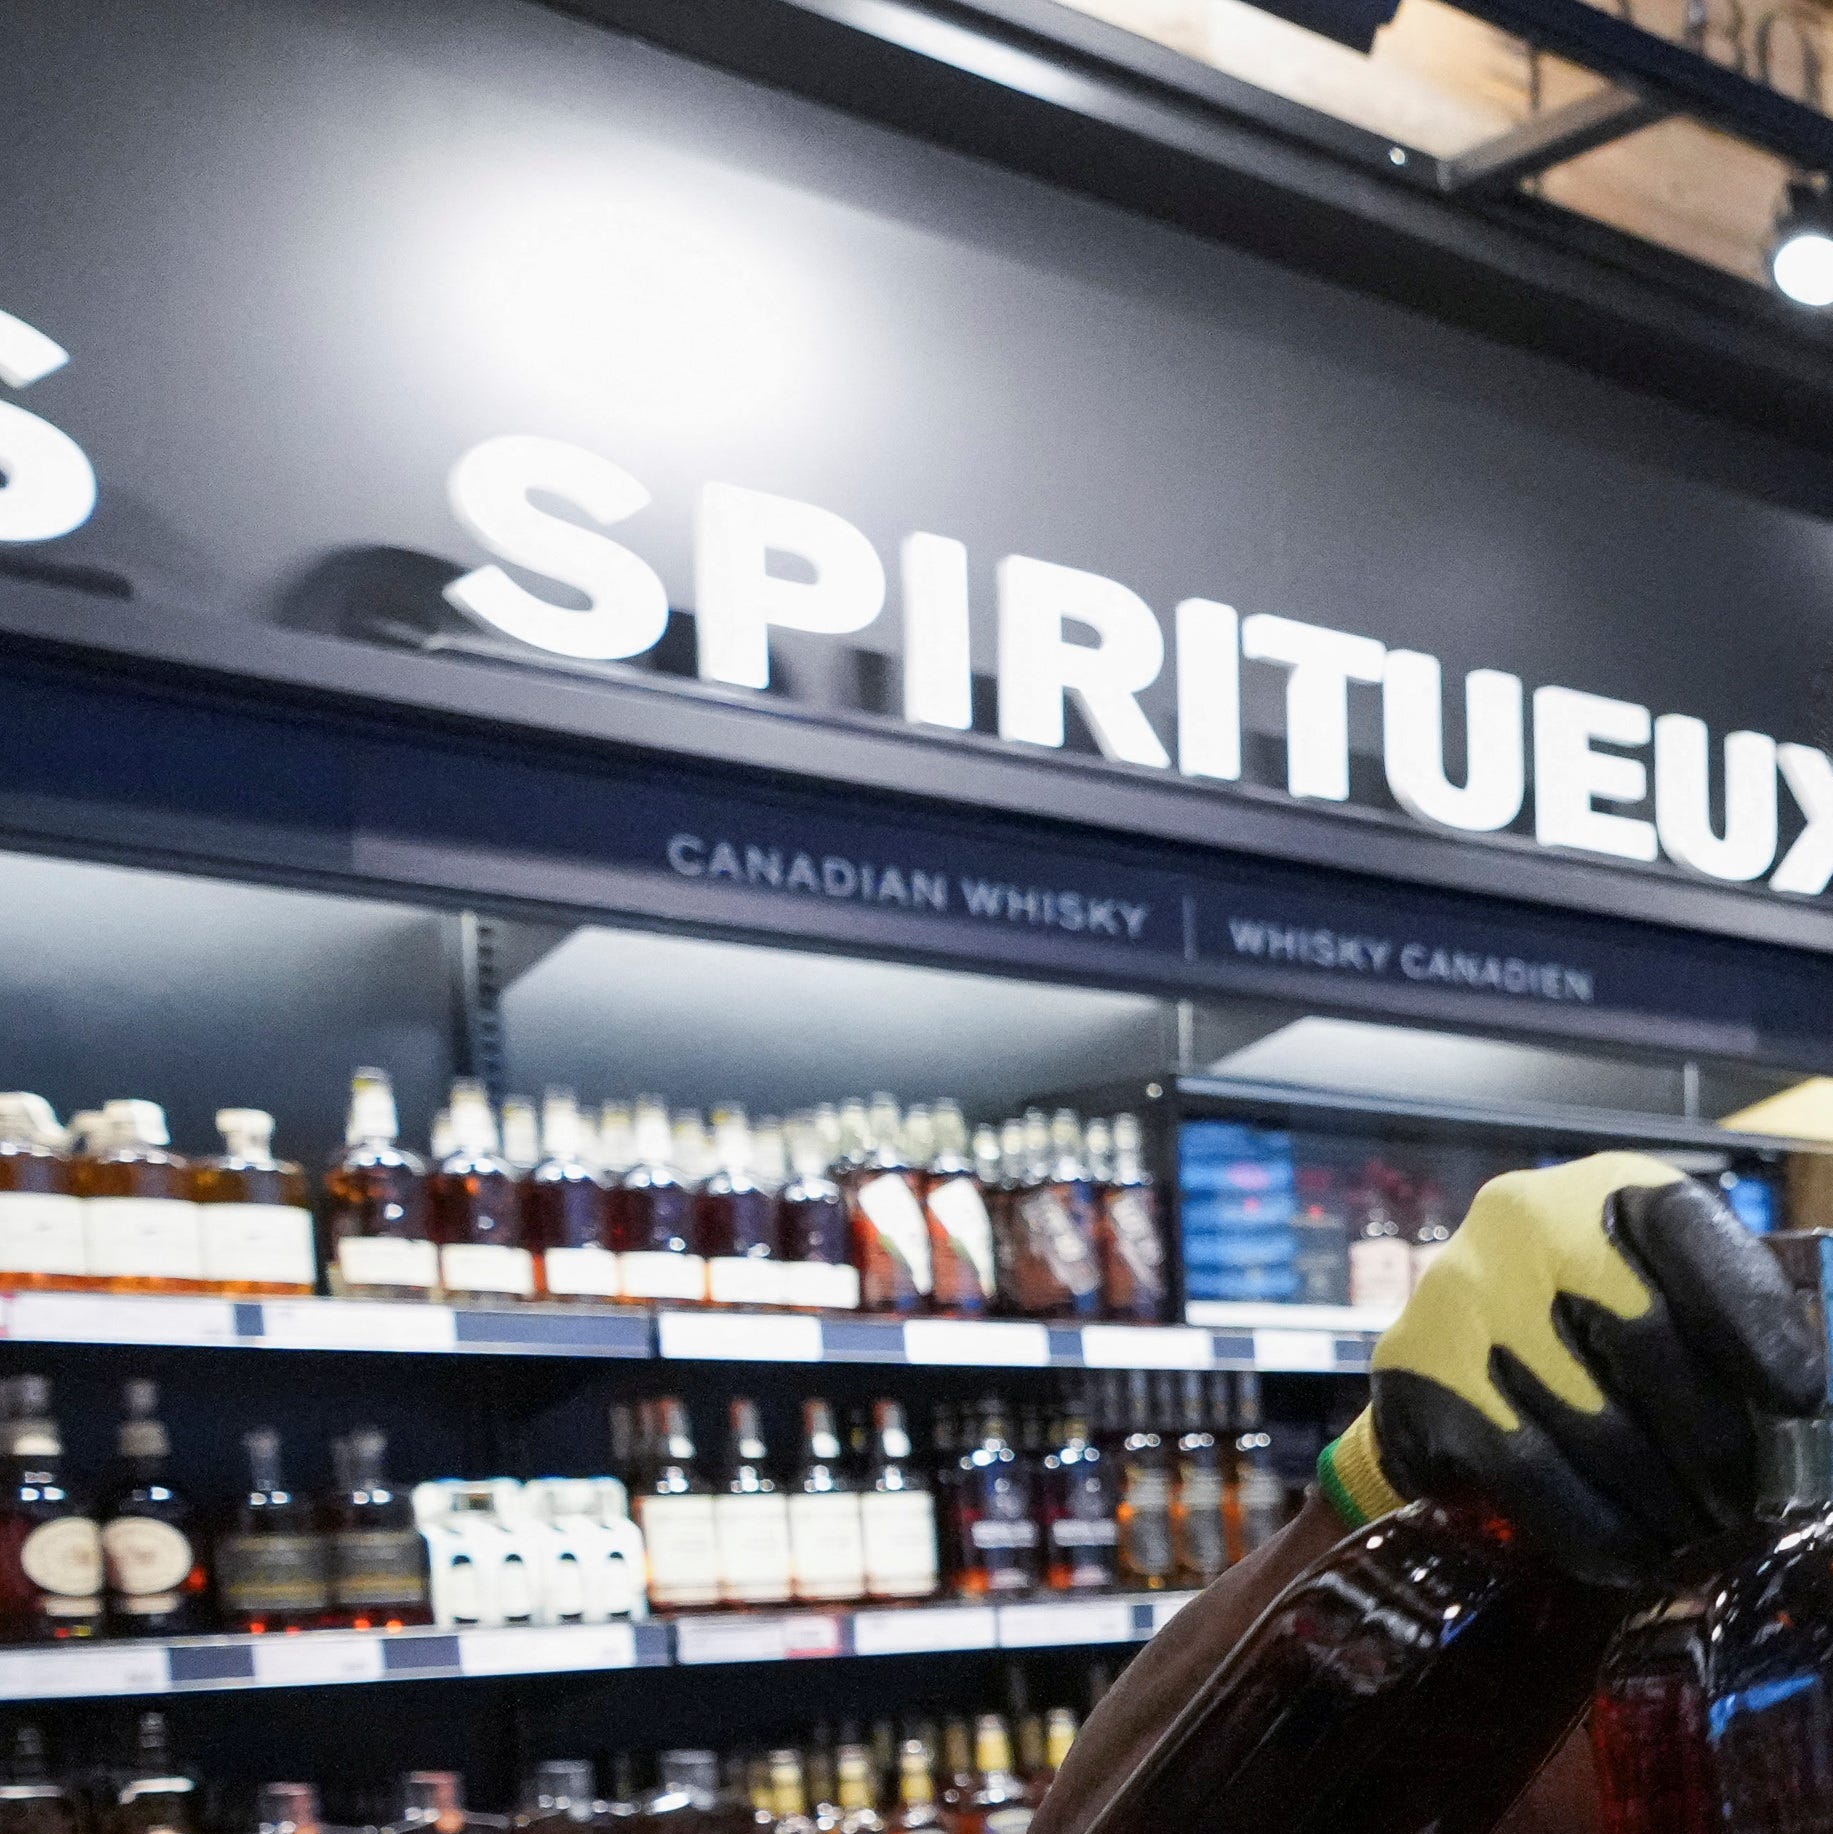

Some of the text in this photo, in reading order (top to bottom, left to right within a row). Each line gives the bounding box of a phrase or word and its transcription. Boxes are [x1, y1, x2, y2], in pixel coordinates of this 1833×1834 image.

[667, 832, 1149, 941] CANADIAN WHISKY
[1227, 919, 1594, 1003] WHISKY CANADIEN
